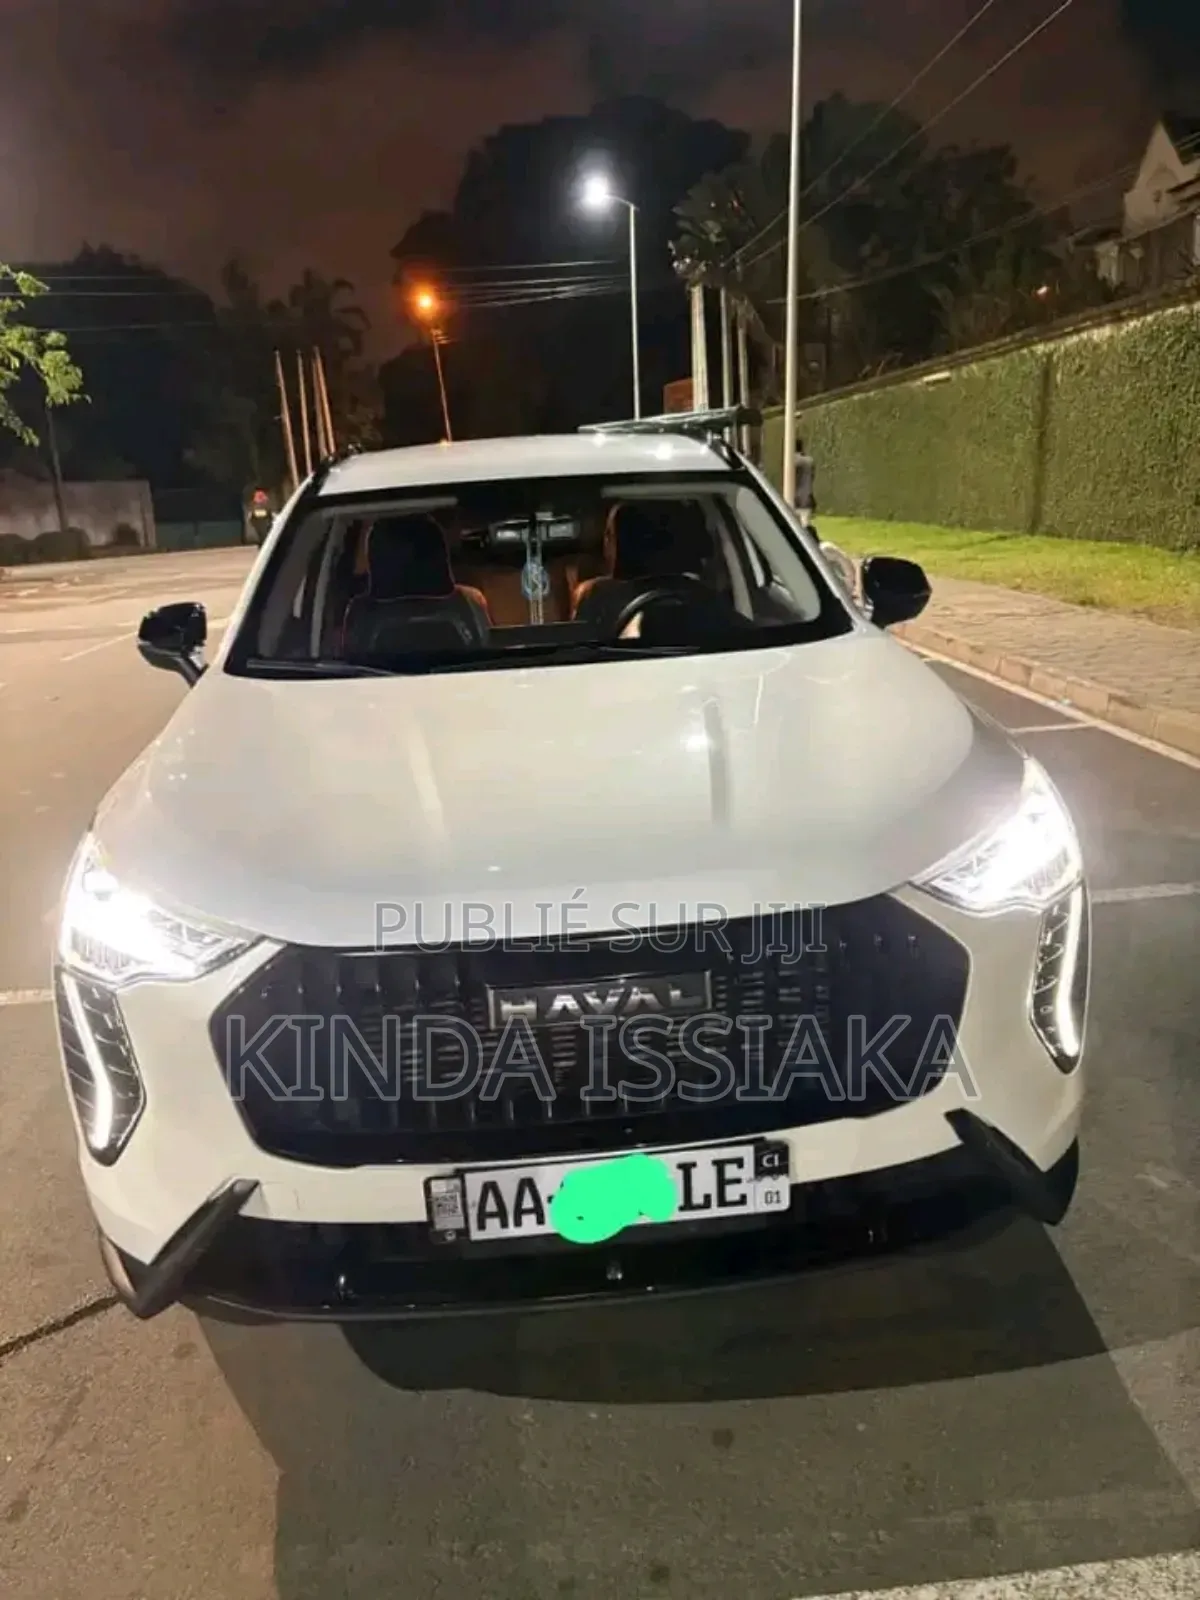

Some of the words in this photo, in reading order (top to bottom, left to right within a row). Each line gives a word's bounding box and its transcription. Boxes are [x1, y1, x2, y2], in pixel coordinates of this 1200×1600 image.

[500, 984, 704, 1021] HAVAL
[762, 1154, 779, 1167] CI
[764, 1190, 781, 1204] 01
